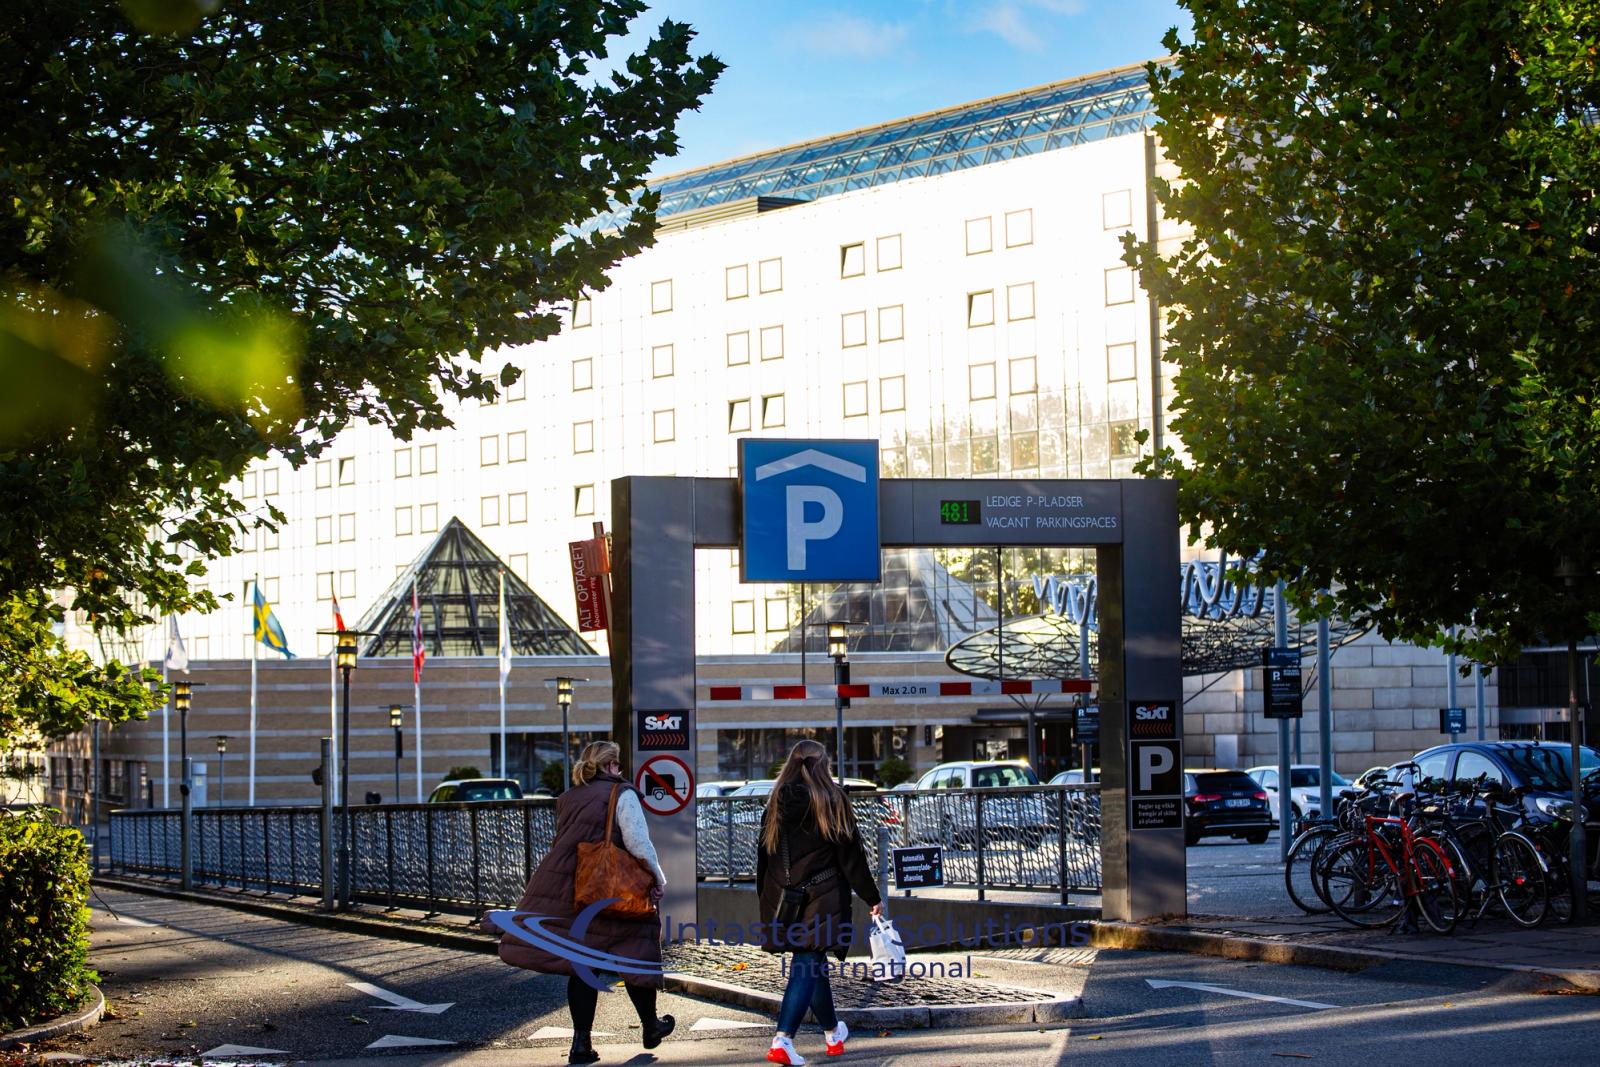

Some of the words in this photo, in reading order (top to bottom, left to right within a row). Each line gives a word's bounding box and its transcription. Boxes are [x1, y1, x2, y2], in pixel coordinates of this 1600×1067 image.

[941, 502, 969, 521] 481
[986, 496, 1021, 507] LEDIGE
[1027, 496, 1083, 507] P-PLADSER
[786, 485, 843, 570] P
[986, 517, 1030, 528] VACANT
[1036, 517, 1117, 528] PARKINGSPACES
[572, 545, 589, 602] OPTAGET
[580, 608, 593, 629] ALT
[882, 686, 900, 695] Max
[902, 686, 917, 695] 2.0
[1139, 745, 1174, 790] P
